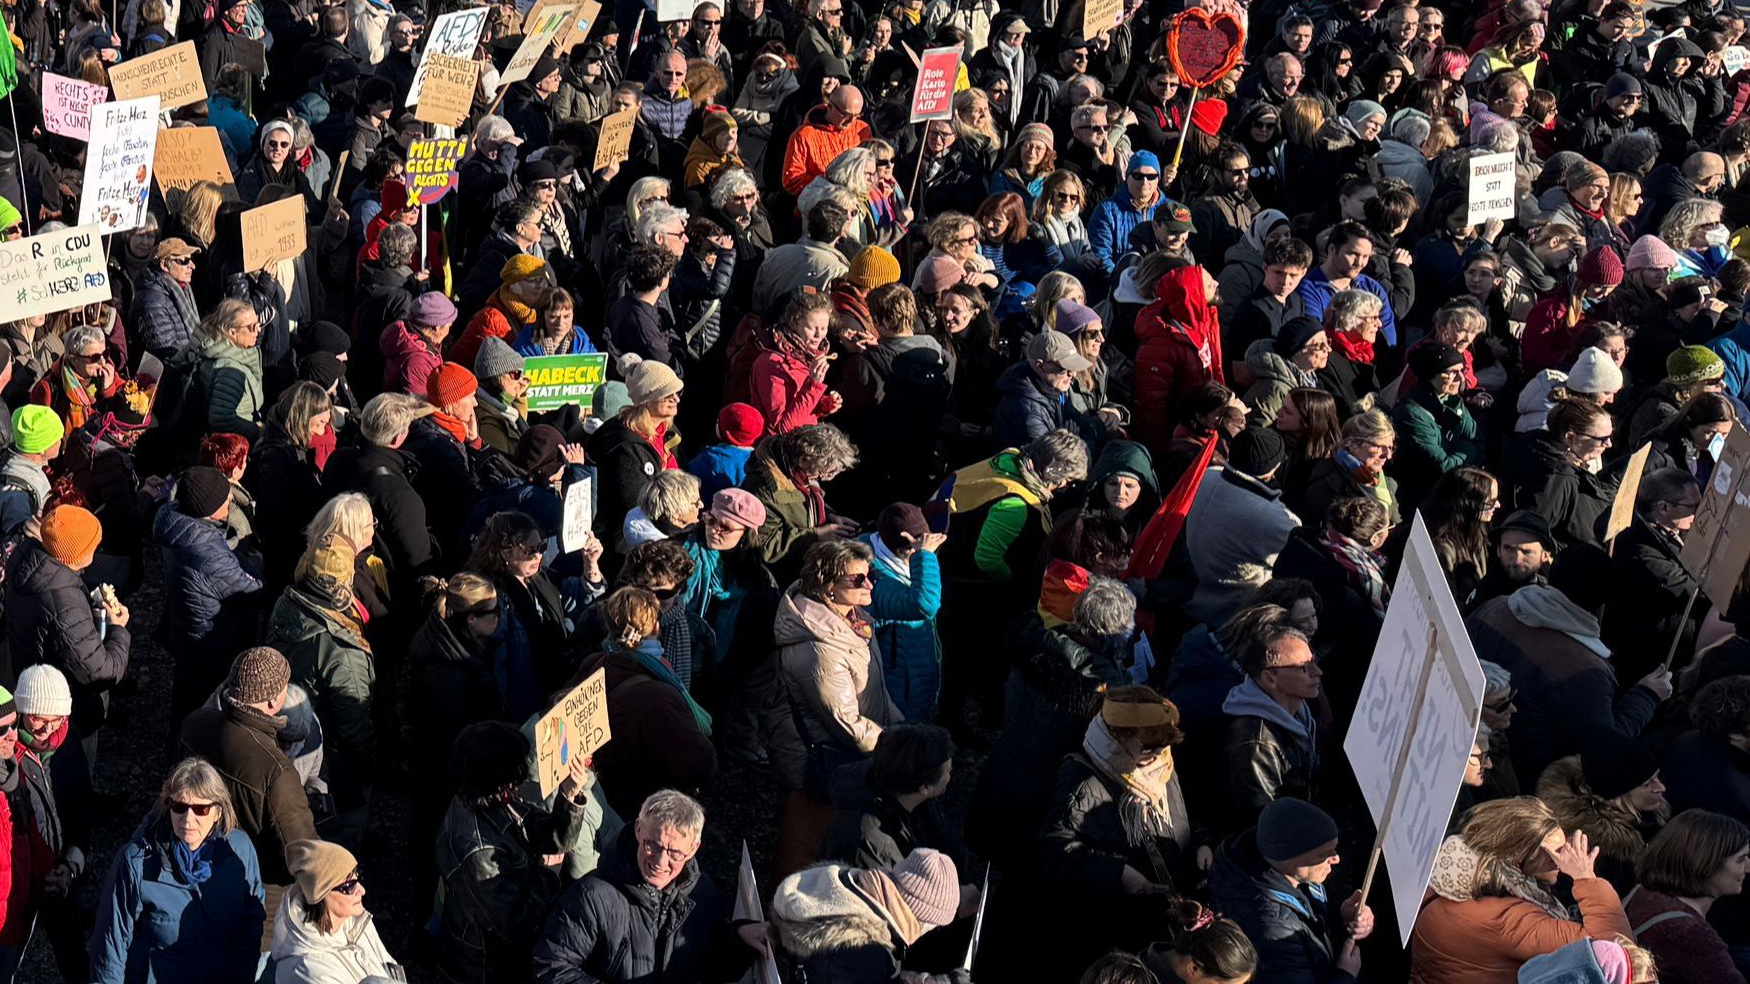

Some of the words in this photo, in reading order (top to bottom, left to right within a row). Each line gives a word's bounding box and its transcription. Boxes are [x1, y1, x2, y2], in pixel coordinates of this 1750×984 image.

[112, 52, 187, 83] MENSCHENRECHTE
[428, 53, 479, 75] SICHERHEIT
[54, 80, 90, 101] RECHTS
[140, 73, 169, 91] STATT
[158, 81, 199, 103] ENSCHEN
[406, 159, 456, 179] GEGEN
[31, 242, 44, 260] R
[65, 234, 91, 253] CDU
[277, 232, 297, 255] 1933
[83, 270, 106, 290] AFD
[525, 365, 603, 388] HABECK
[526, 385, 561, 399] STATT
[562, 383, 595, 397] MERZ
[573, 700, 599, 726] GEGEN
[578, 719, 595, 740] DIE
[578, 730, 604, 757] AFD
